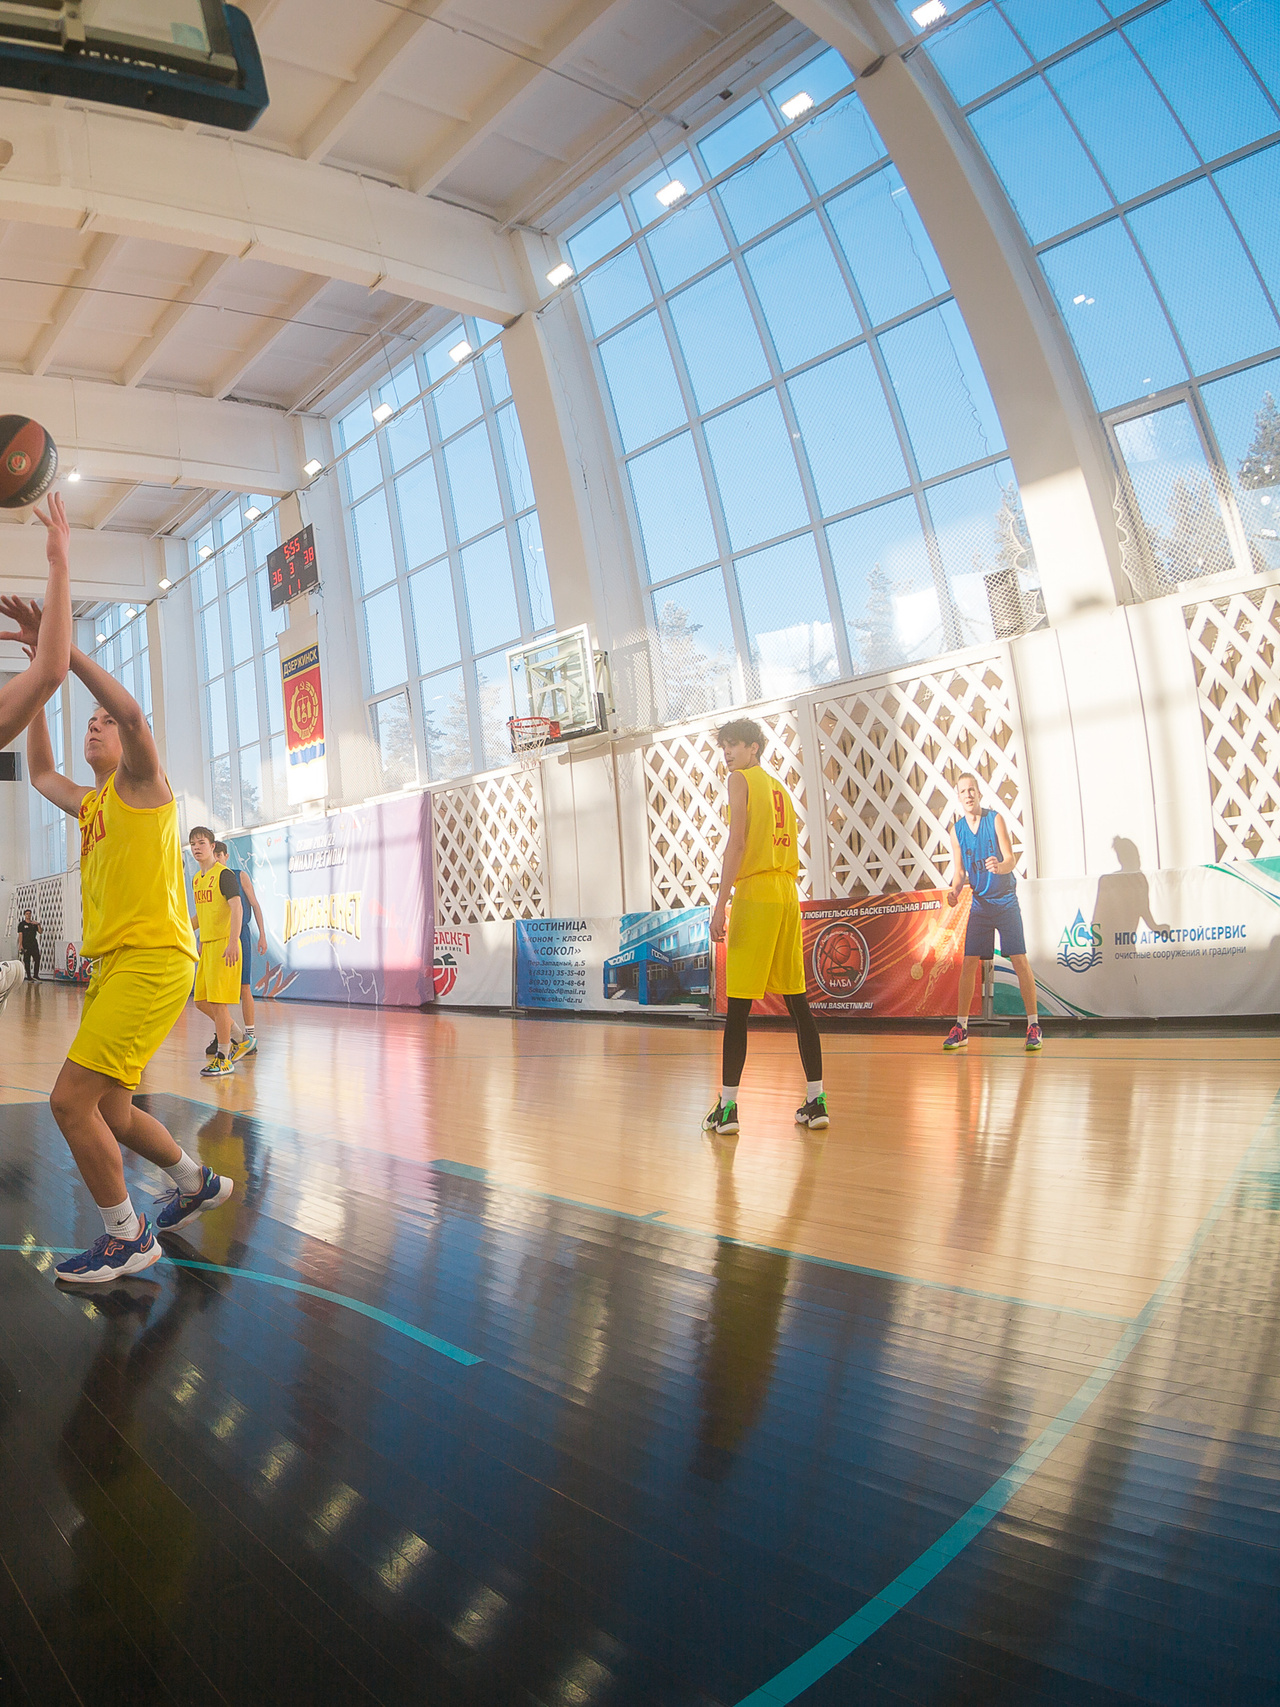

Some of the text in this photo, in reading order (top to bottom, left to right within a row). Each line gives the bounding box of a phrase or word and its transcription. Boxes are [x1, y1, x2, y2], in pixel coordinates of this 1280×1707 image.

[303, 546, 315, 565] 38
[272, 568, 283, 586] 36
[289, 562, 295, 575] 3
[283, 648, 318, 677] ДЗЕРЖИНСК
[772, 789, 785, 829] 9
[288, 846, 348, 874] ФИНАЛ РЕГИОНА
[208, 875, 215, 888] 2
[804, 907, 859, 919] ЛЮБИТЕЛЬСКАЯ
[859, 902, 920, 916] БАСКЕТБОЛЬНАЯ
[920, 900, 942, 911] ЛИГА
[526, 921, 587, 933] ГОСТИНИЦА
[1057, 923, 1103, 947] ACS
[1114, 924, 1247, 945] НПО АГРОСТРОЙСЕРВИС
[562, 934, 592, 943] класса
[534, 946, 581, 956] «СОКОЛ»
[1114, 950, 1151, 960] очистные
[1152, 948, 1200, 960] сооружения
[1209, 946, 1247, 957] градирни
[809, 1002, 873, 1010] WWW.BASKETNN.RU
